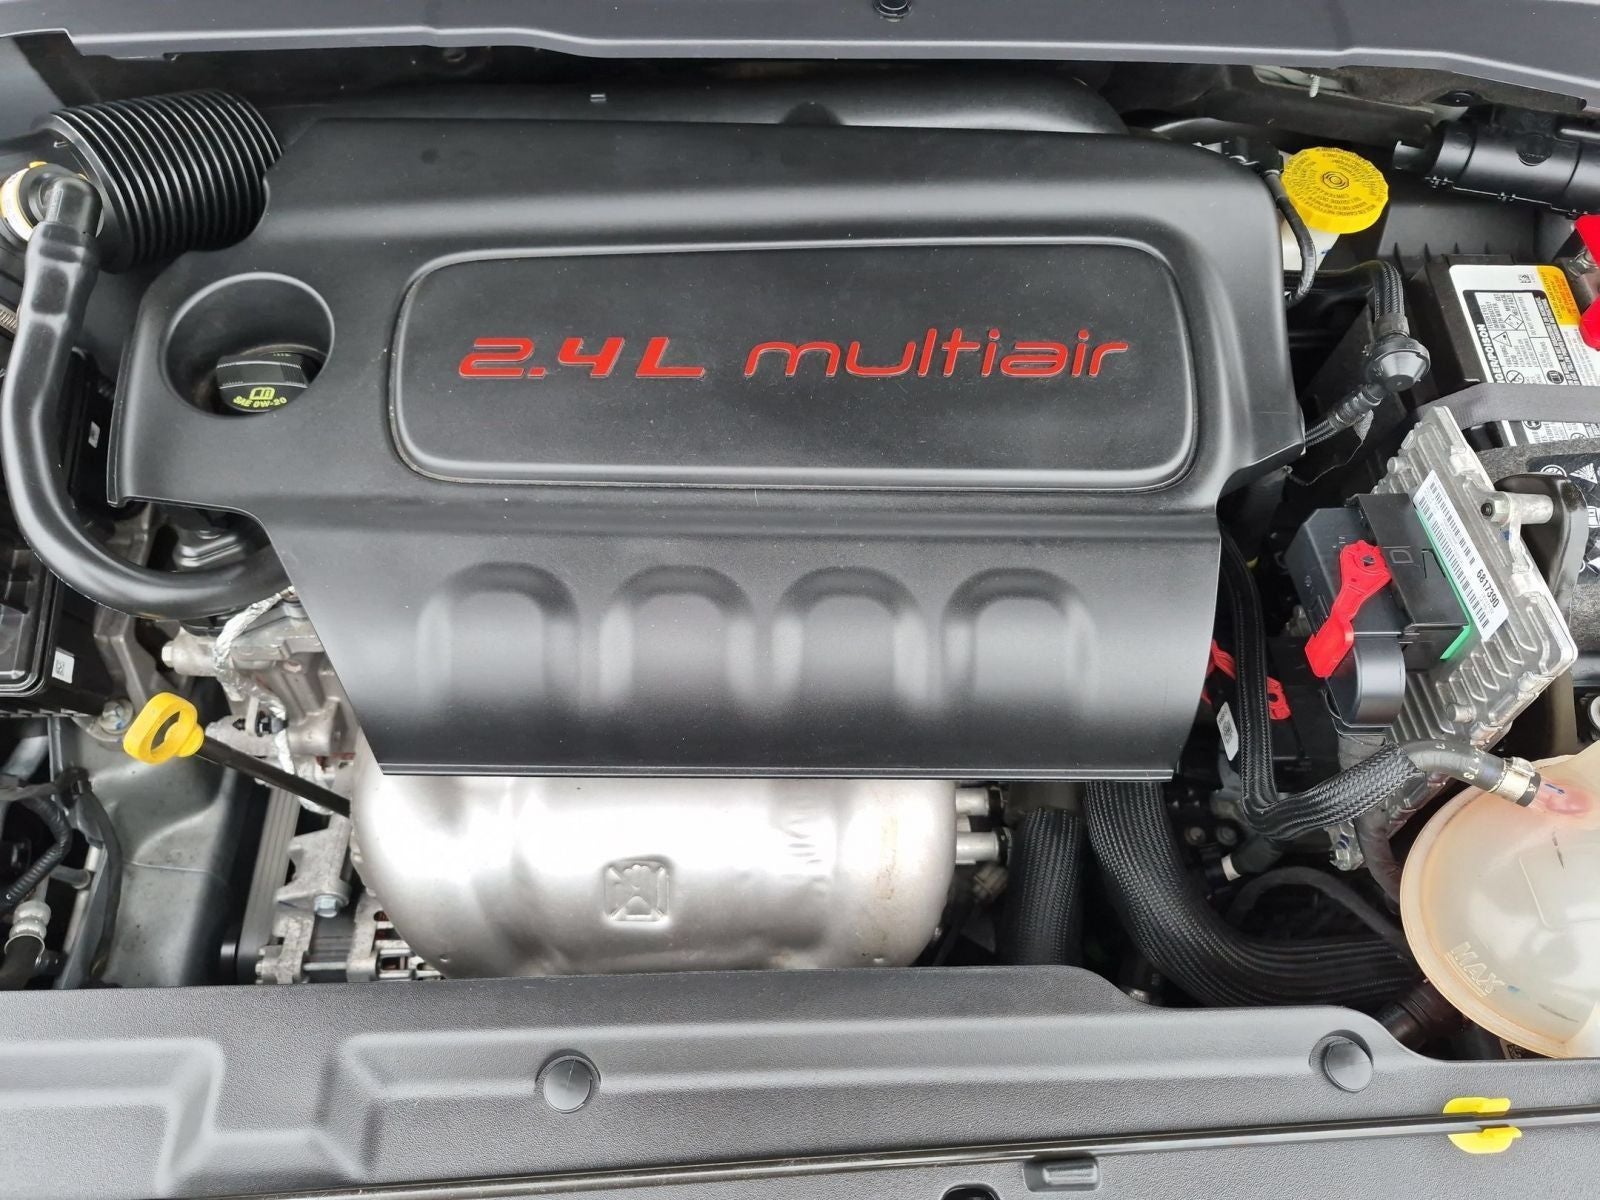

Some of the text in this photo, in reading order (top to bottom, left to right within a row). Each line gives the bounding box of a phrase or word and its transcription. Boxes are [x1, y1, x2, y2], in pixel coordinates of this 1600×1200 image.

[743, 327, 1129, 378] multiair
[1476, 323, 1505, 383] GER/POISON
[233, 396, 287, 408] SAE 0W-20
[1476, 569, 1500, 608] 6817390
[1450, 941, 1506, 994] MAX
